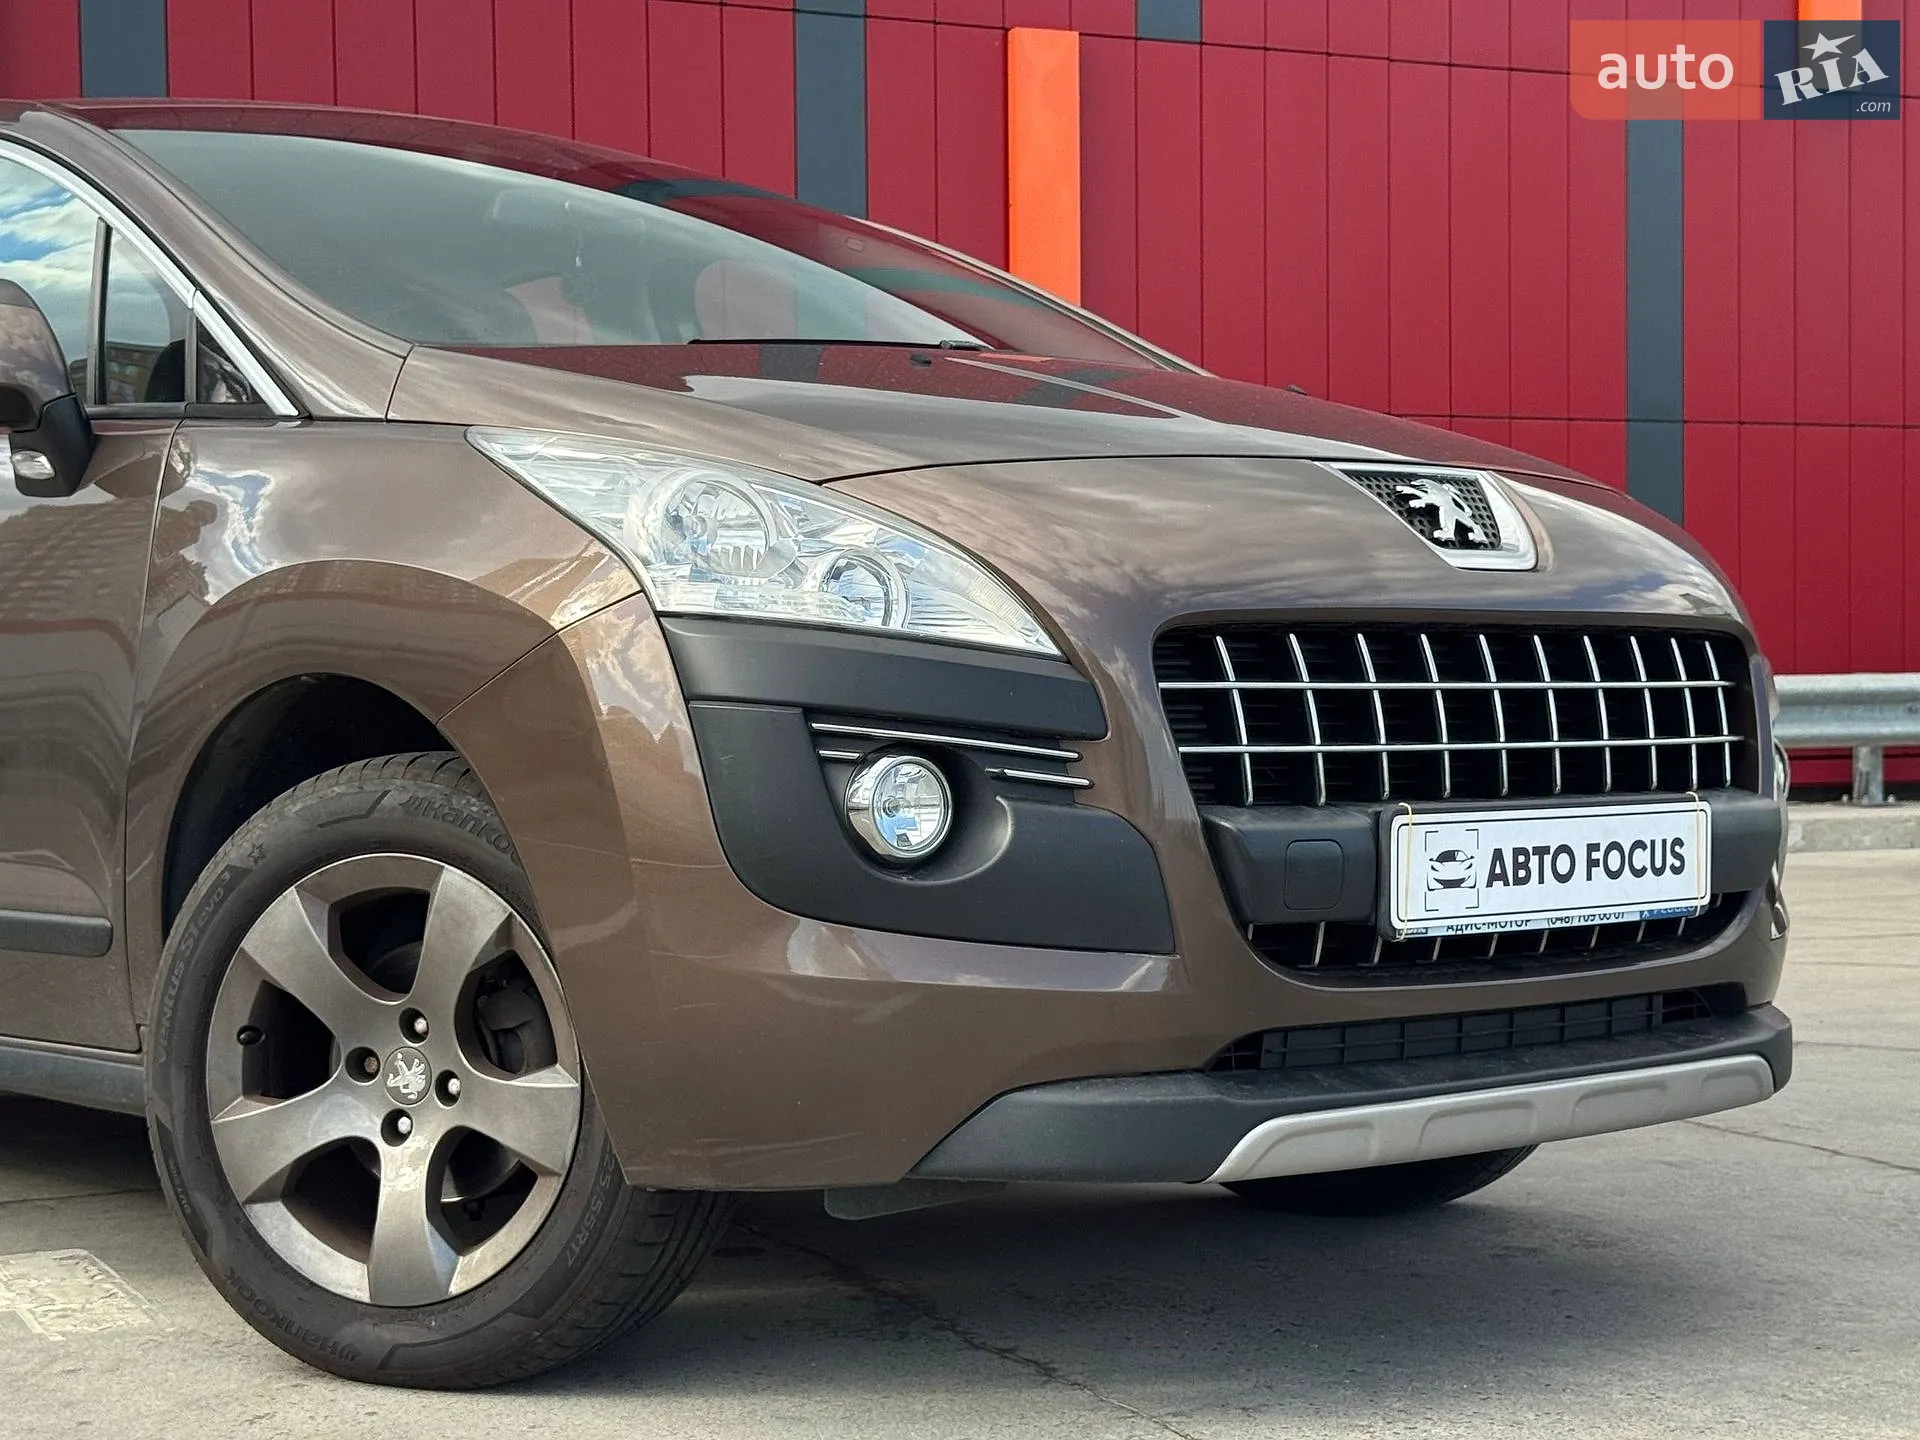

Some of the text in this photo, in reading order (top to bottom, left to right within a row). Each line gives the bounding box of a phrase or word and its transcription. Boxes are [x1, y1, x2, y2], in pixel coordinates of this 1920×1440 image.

[1486, 836, 1685, 889] АВТО FOCUS
[566, 1141, 615, 1268] 25/55R17
